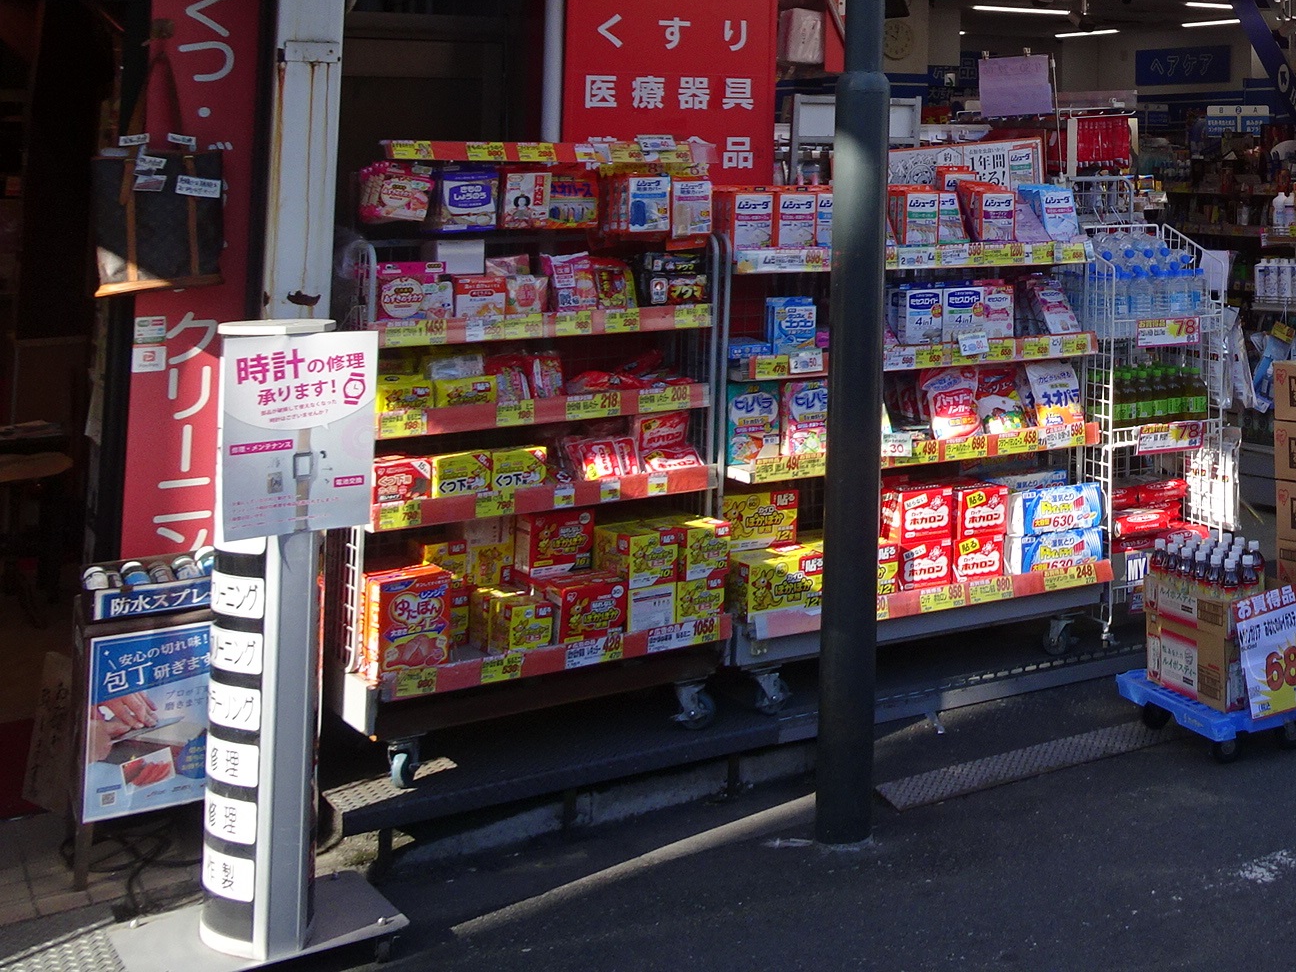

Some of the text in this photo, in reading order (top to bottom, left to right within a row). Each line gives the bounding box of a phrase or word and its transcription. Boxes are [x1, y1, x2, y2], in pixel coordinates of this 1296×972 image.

[597, 13, 748, 51] くすり
[1150, 54, 1214, 77] ヘアケア
[584, 74, 755, 110] 医療器具
[970, 153, 1006, 171] 1年間
[737, 200, 771, 210] ムシューダ
[781, 200, 814, 210] ムシューダ
[908, 199, 937, 209] ムシューダ
[984, 198, 1013, 208] ムシューダ
[915, 316, 934, 327] 4in1
[955, 315, 973, 325] 4in1
[1174, 320, 1196, 335] 78
[236, 348, 365, 385] 時計の修理
[671, 387, 687, 401] 208
[601, 394, 618, 408] 218
[1023, 430, 1037, 444] 458
[1070, 424, 1084, 437] 598
[1178, 424, 1199, 439] 78
[888, 442, 905, 454] 30
[922, 442, 937, 454] 498
[971, 437, 986, 450] 698
[776, 493, 796, 506] 貼る
[906, 496, 926, 509] 貼らない
[968, 493, 984, 506] 貼る
[1051, 493, 1075, 503] 湿気とり
[757, 506, 775, 516] カイロ
[909, 514, 944, 526] ホカロン
[968, 512, 1001, 524] ホカロン
[1051, 514, 1074, 528] 630
[962, 541, 978, 552] 貼る
[908, 565, 943, 577] ホカロン
[961, 559, 995, 571] ホカロン
[1127, 558, 1146, 582] MY
[786, 572, 804, 583] カイロ
[1076, 566, 1093, 579] 248
[996, 578, 1010, 591] 980
[948, 585, 962, 599] 958
[110, 588, 211, 616] 防水スプレ
[1237, 585, 1296, 620] お買得品
[694, 619, 715, 637] 1058
[602, 635, 620, 651] 428
